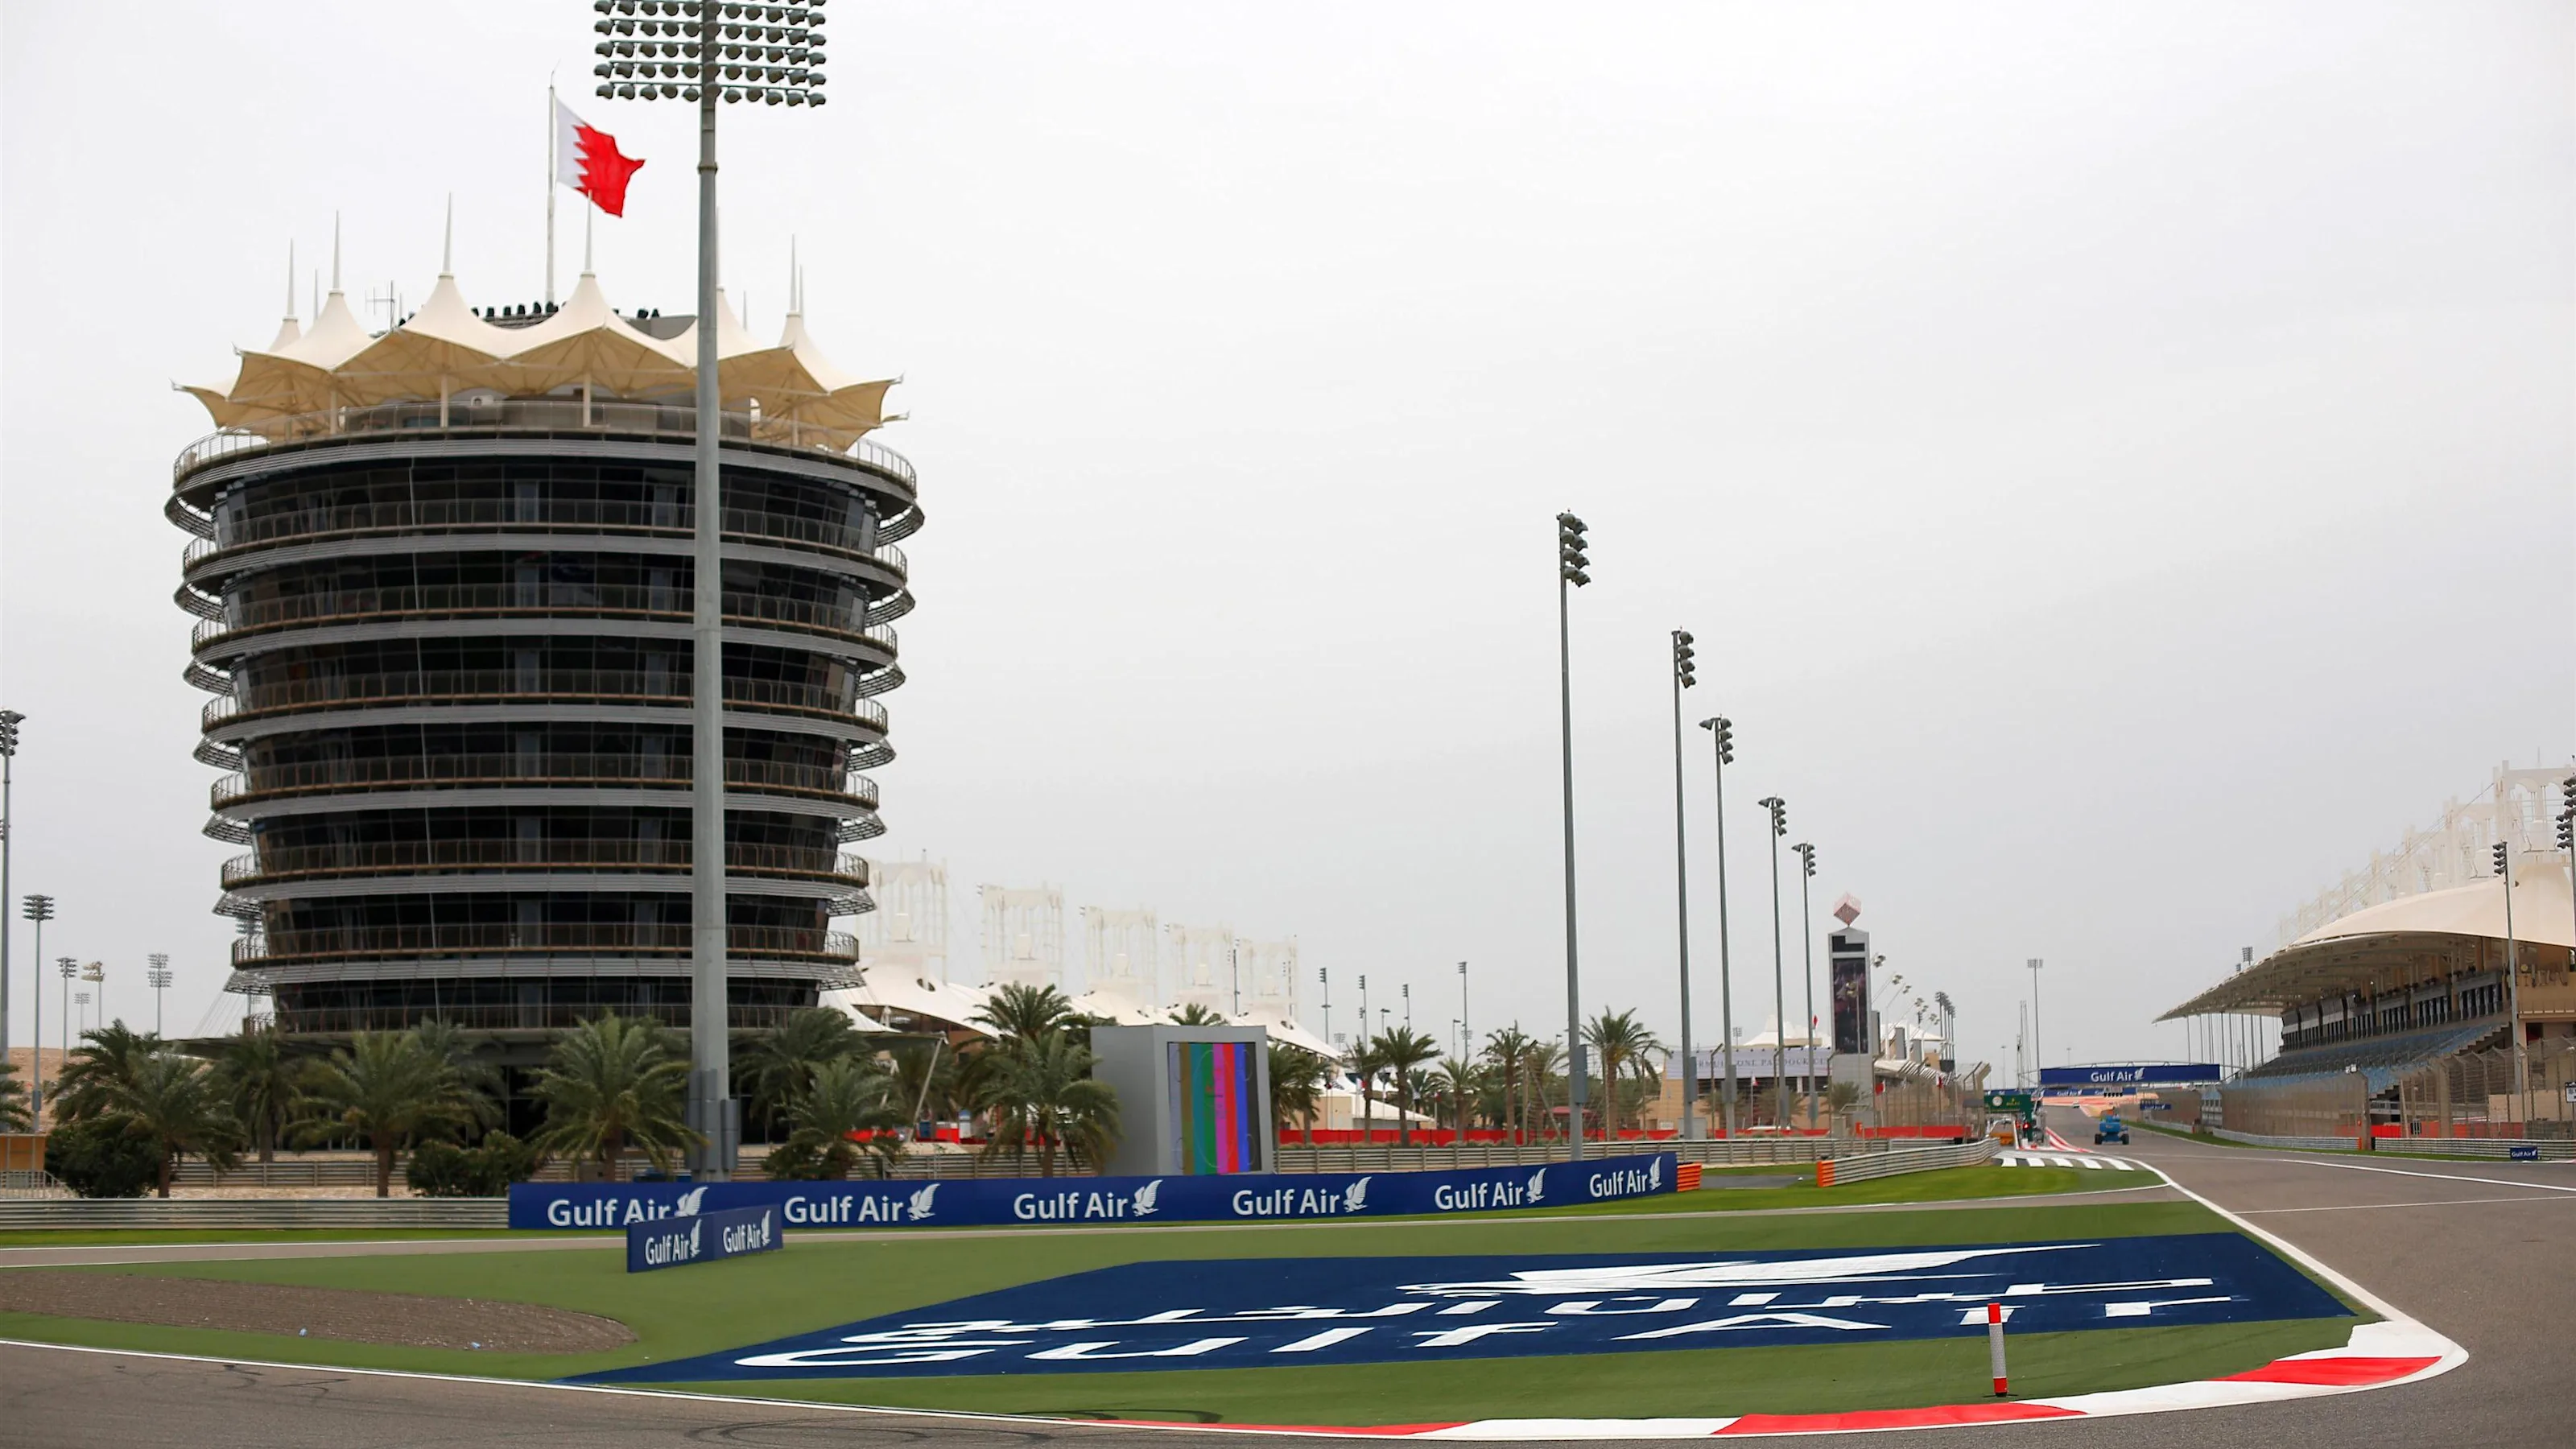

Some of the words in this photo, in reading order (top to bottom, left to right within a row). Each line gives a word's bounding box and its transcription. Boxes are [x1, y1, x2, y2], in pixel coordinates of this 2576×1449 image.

[1761, 1058, 1809, 1067] PADOCK
[2091, 1071, 2115, 1083] Gulf
[2116, 1071, 2133, 1081] Air
[1435, 1183, 1488, 1210] Gulf
[1492, 1182, 1524, 1207] Air
[1589, 1170, 1624, 1198] Gulf
[1625, 1170, 1648, 1194] Air
[547, 1199, 617, 1226] Gulf
[622, 1199, 671, 1225] Air
[784, 1196, 853, 1223] Gulf
[858, 1195, 904, 1222] Air
[1013, 1192, 1080, 1220] Gulf
[1084, 1192, 1128, 1218] Air
[1232, 1189, 1295, 1216] Gulf
[1299, 1189, 1340, 1214] Air
[645, 1235, 671, 1265] Gulf
[672, 1234, 690, 1261] Air
[723, 1224, 747, 1253] Gulf
[747, 1224, 762, 1249] Air
[732, 1321, 1559, 1368] Gulf
[1610, 1295, 2235, 1342] Air
